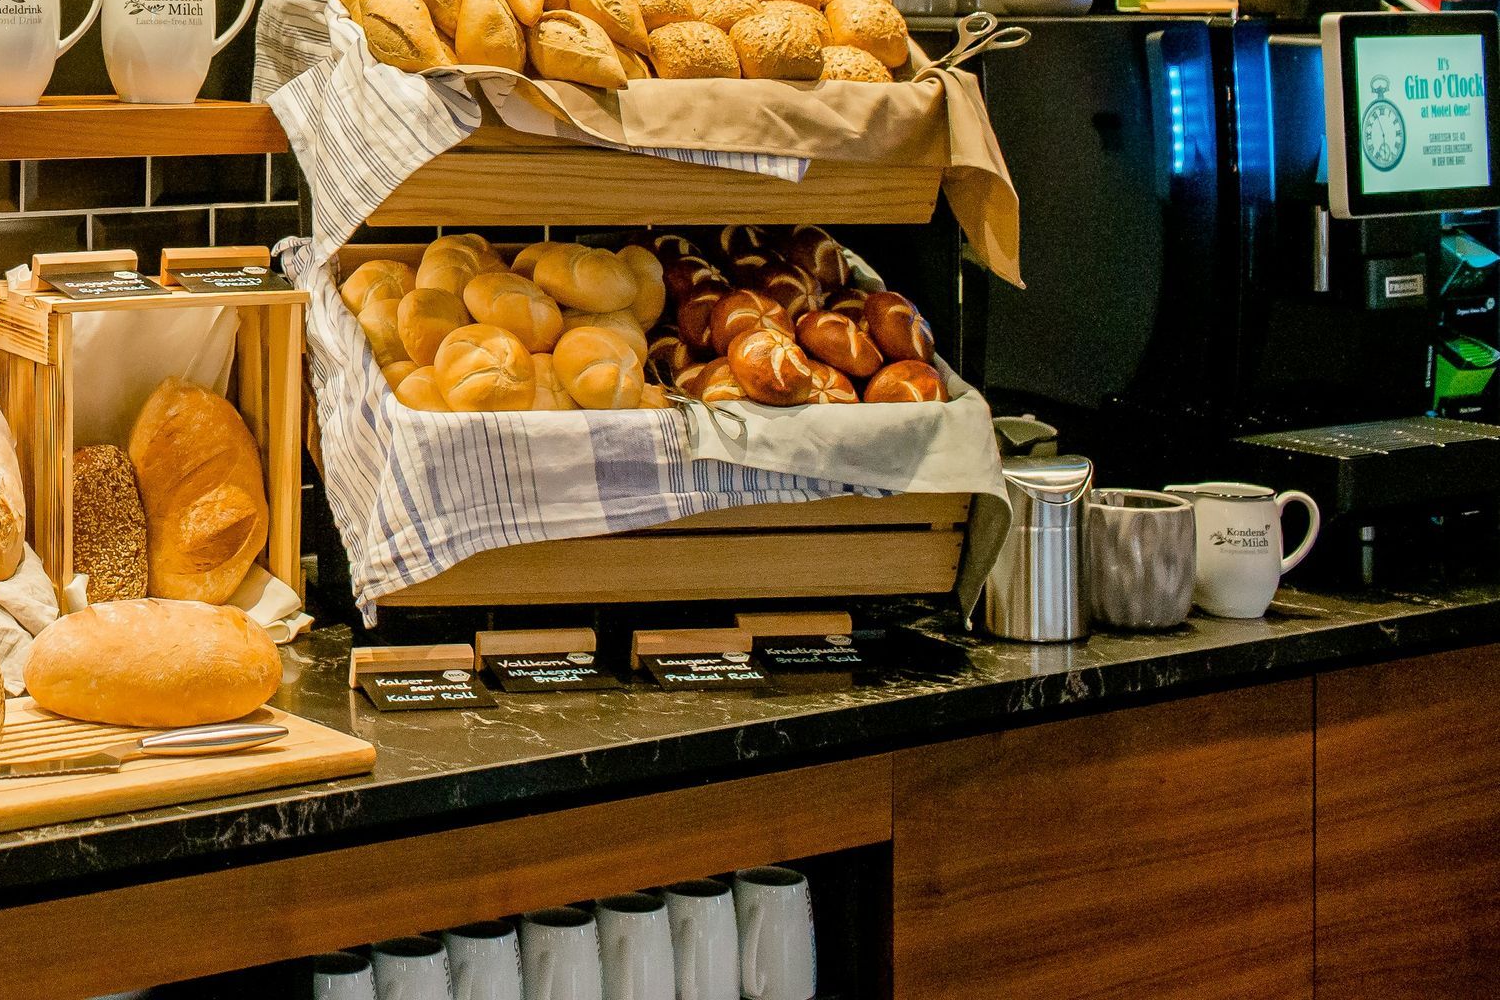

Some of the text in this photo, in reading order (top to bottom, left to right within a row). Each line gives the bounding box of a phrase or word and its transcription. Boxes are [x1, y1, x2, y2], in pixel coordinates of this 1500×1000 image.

[167, 2, 204, 16] Milch
[1404, 73, 1429, 100] Gin
[1241, 537, 1269, 548] Milch
[497, 659, 571, 668] Vollkorn
[656, 657, 723, 667] Laugen-
[690, 662, 752, 672] semmel
[507, 667, 598, 678] Wholegrain
[664, 671, 765, 682] Pretzel Roll
[375, 678, 434, 687] Kaiser-
[532, 674, 583, 684] Bread
[409, 682, 473, 692] semmel
[386, 691, 478, 703] Kaiser Roll
